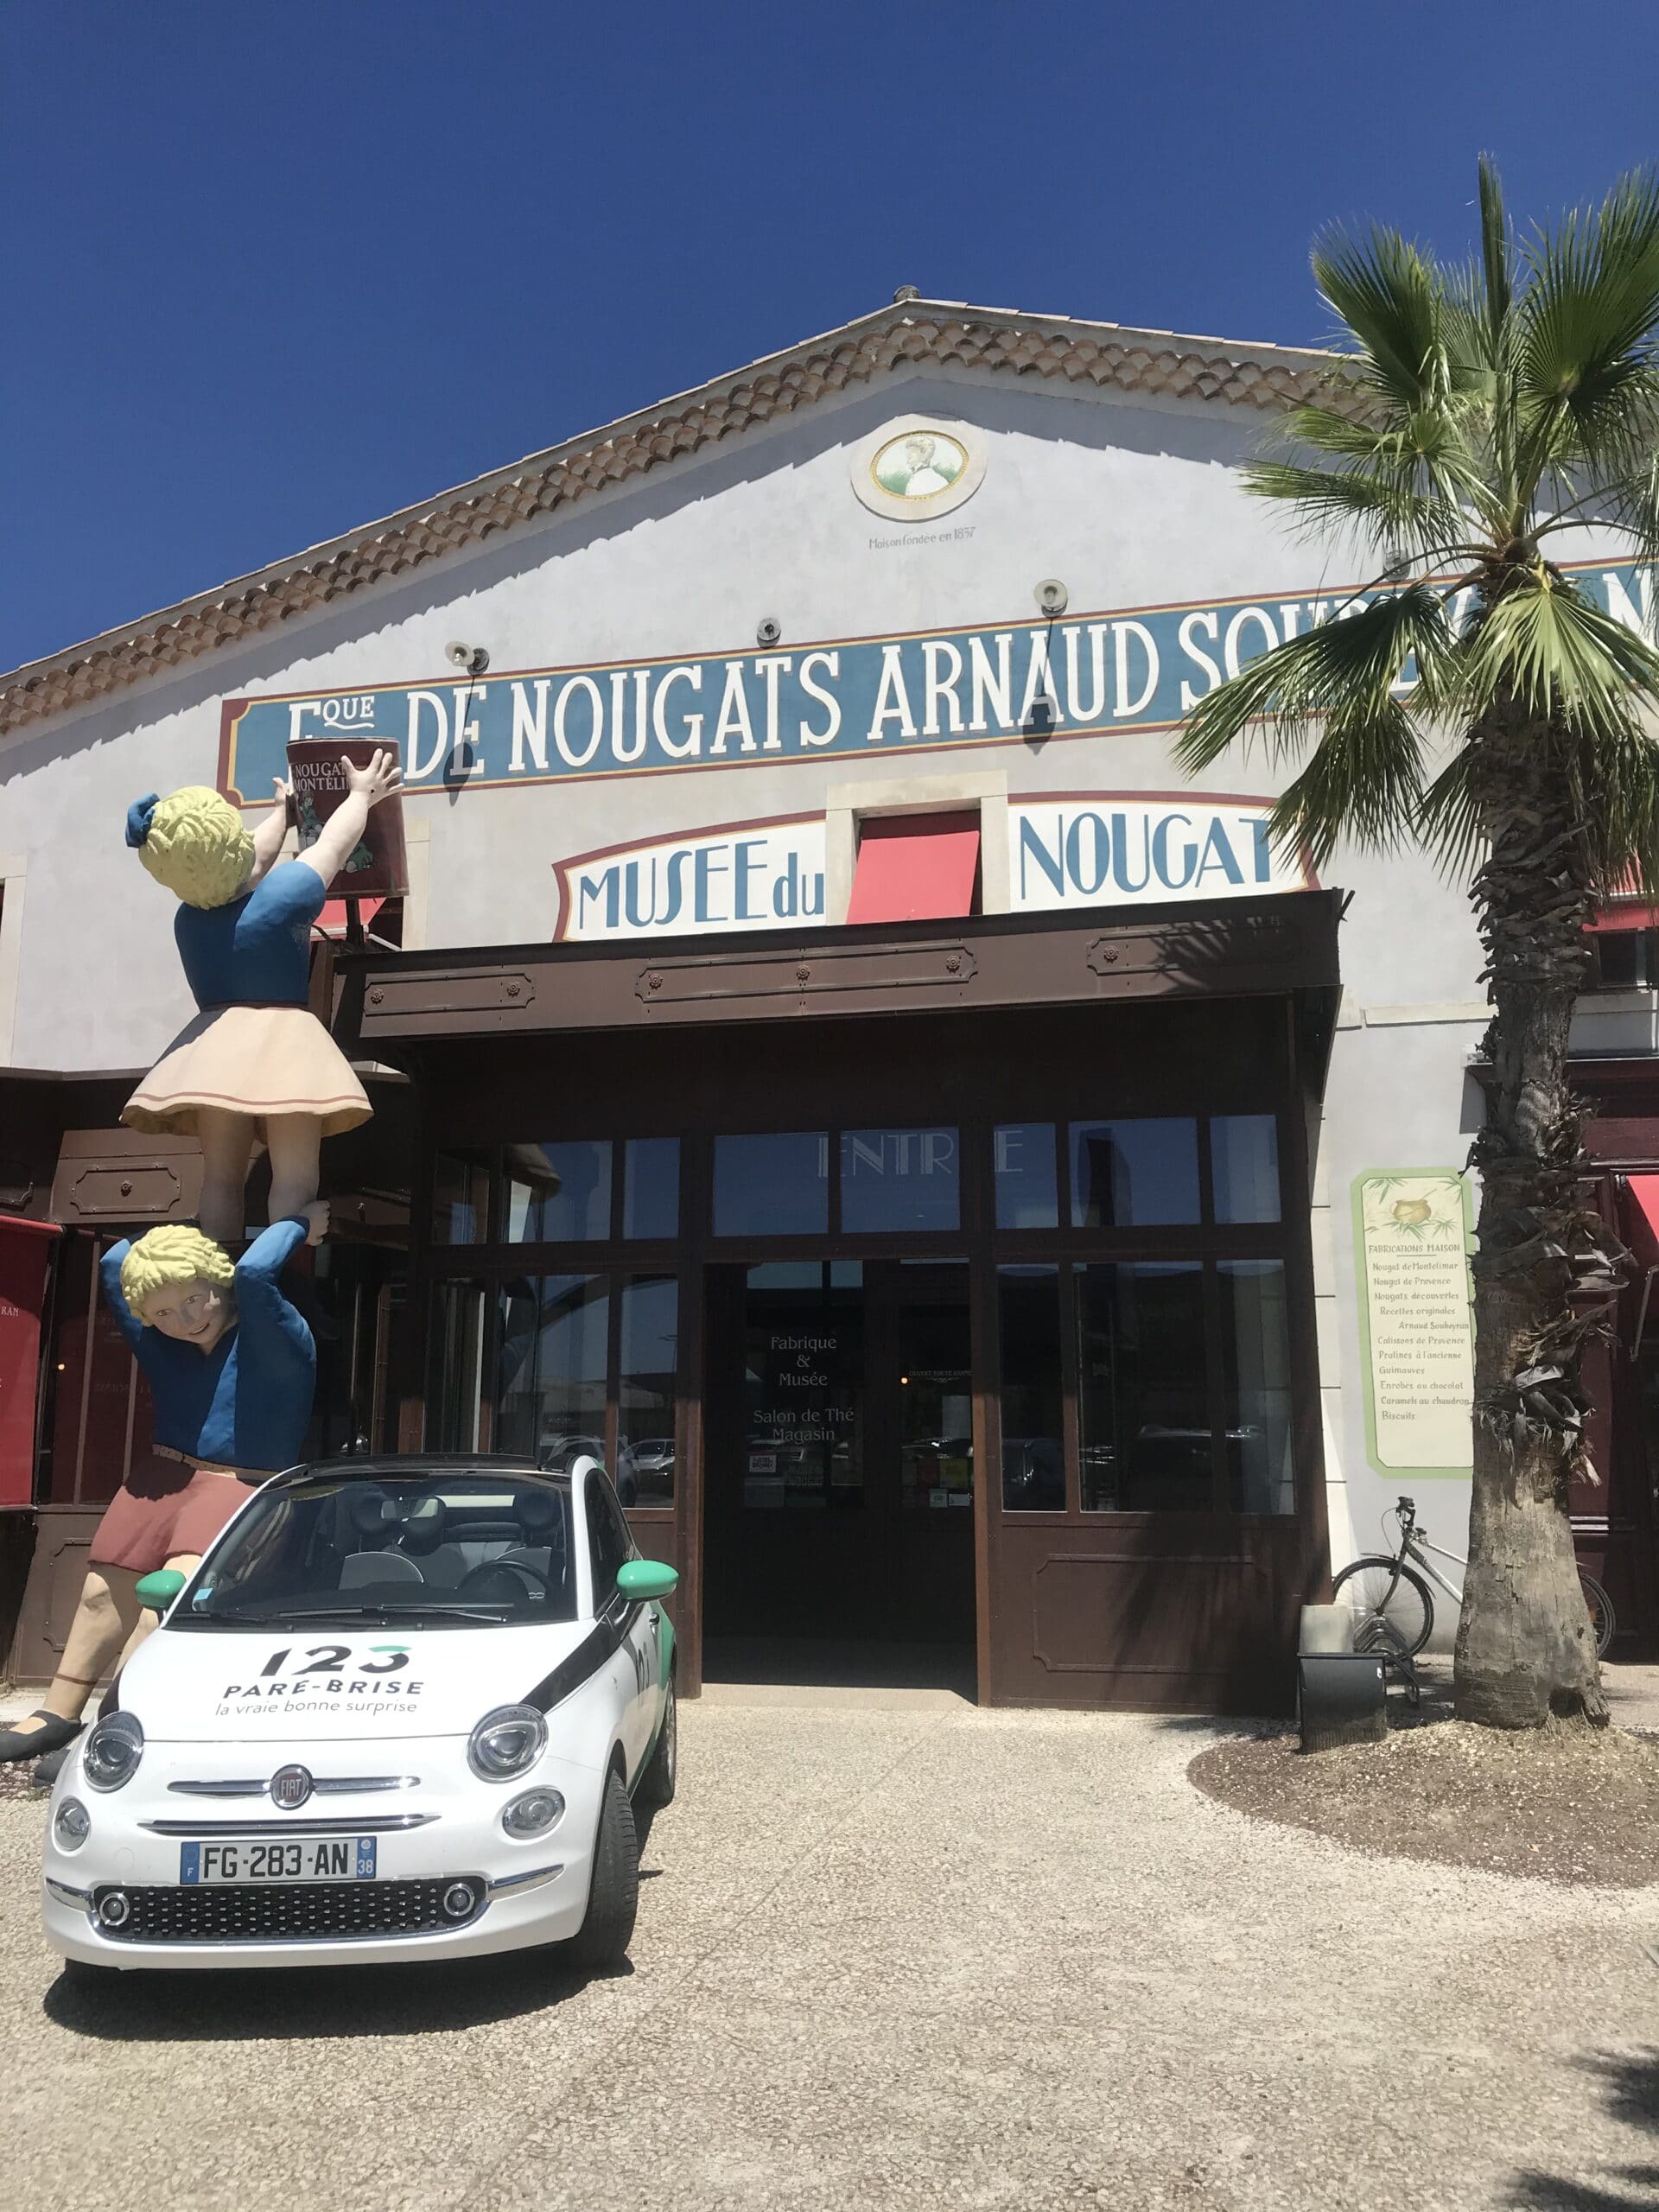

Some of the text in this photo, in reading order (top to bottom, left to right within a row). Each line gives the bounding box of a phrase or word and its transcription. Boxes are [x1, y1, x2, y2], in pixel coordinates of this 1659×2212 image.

[868, 537, 901, 550] Maison
[939, 533, 951, 542] en
[402, 684, 487, 779] DE
[508, 651, 841, 772] NOUGATS
[867, 620, 1160, 741] ARNAUD
[1019, 811, 1272, 901] NOUGAT
[579, 839, 825, 931] MUSEE du
[1368, 1243, 1460, 1254] FABRICATIONS MAISON
[1372, 1262, 1400, 1274] Nougat
[1402, 1262, 1411, 1271] de
[1373, 1276, 1452, 1288] Nougat de Provence
[1374, 1292, 1408, 1303] Nougats
[1380, 1306, 1456, 1317] Recettes originales
[1398, 1321, 1470, 1332] Arnaud Soubeyran
[770, 1336, 837, 1352] Fabrique
[1377, 1335, 1465, 1344] Calissons de Provence
[796, 1354, 810, 1368] &
[1378, 1350, 1413, 1360] Pralines
[1378, 1366, 1426, 1375] Guimauves
[779, 1371, 829, 1387] Musée
[1429, 1381, 1464, 1389] chocolat
[1380, 1395, 1418, 1405] Caramels
[1432, 1395, 1470, 1405] chaudron
[753, 1407, 855, 1424] Salon de Thé
[1382, 1410, 1416, 1421] Biscuits
[772, 1427, 836, 1445] Magasin
[259, 1644, 413, 1678] 123
[222, 1679, 425, 1699] PARE-BRISE
[215, 1699, 417, 1717] la vraie bonne surprise
[281, 1778, 302, 1798] FIAT
[187, 1867, 194, 1878] F
[203, 1842, 349, 1878] FG-283-AN
[357, 1859, 373, 1875] 38
